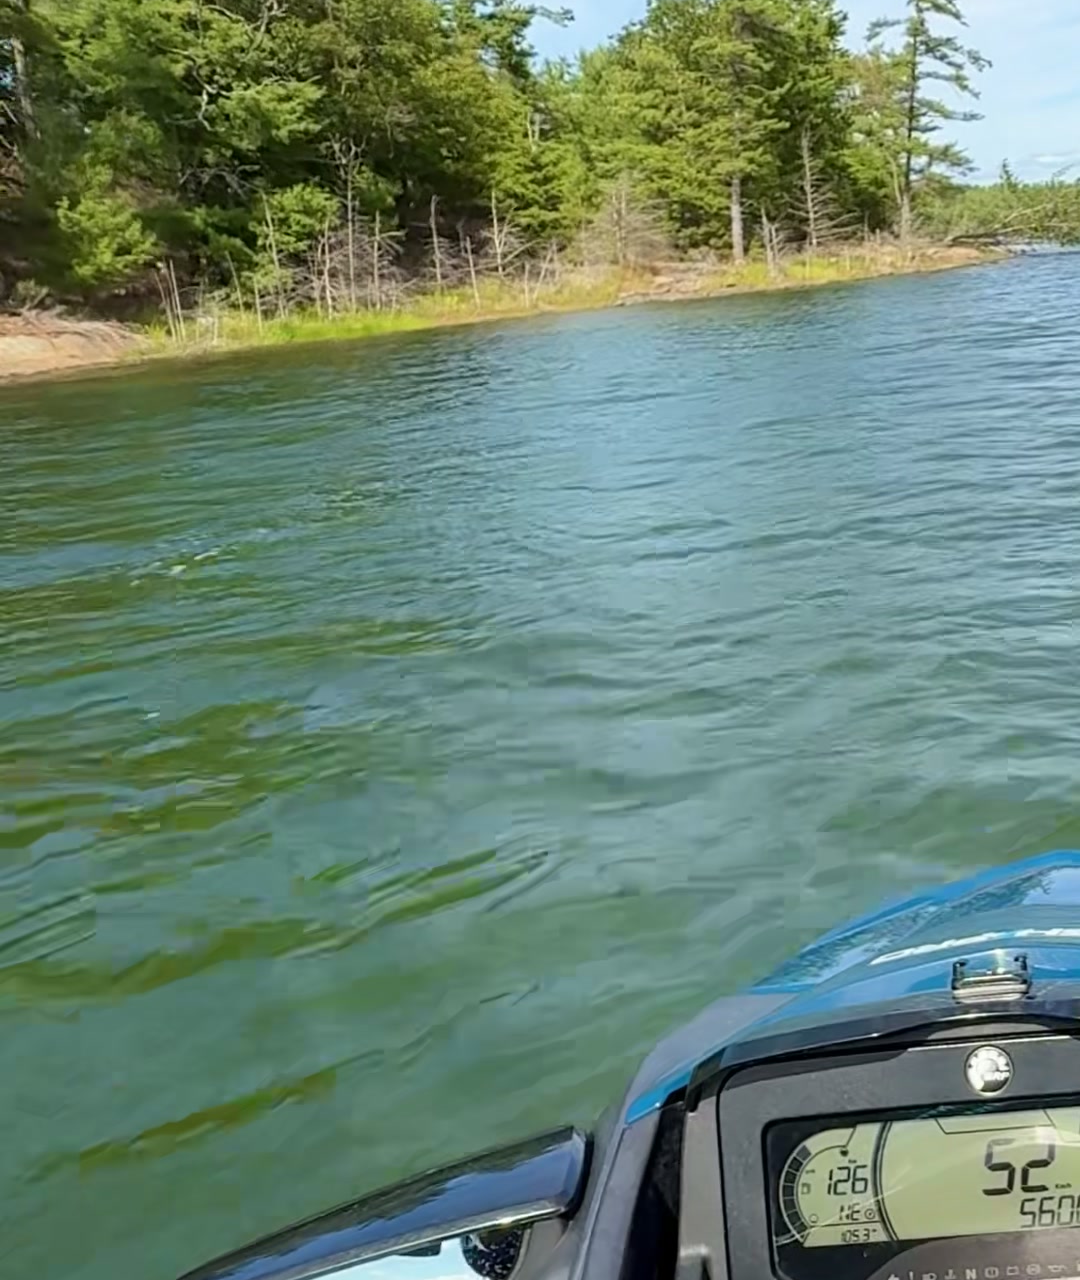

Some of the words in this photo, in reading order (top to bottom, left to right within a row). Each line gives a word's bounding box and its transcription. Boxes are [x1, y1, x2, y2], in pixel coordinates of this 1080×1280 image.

[827, 1164, 868, 1196] 126
[982, 1138, 1056, 1196] 52
[966, 1269, 977, 1280] N
